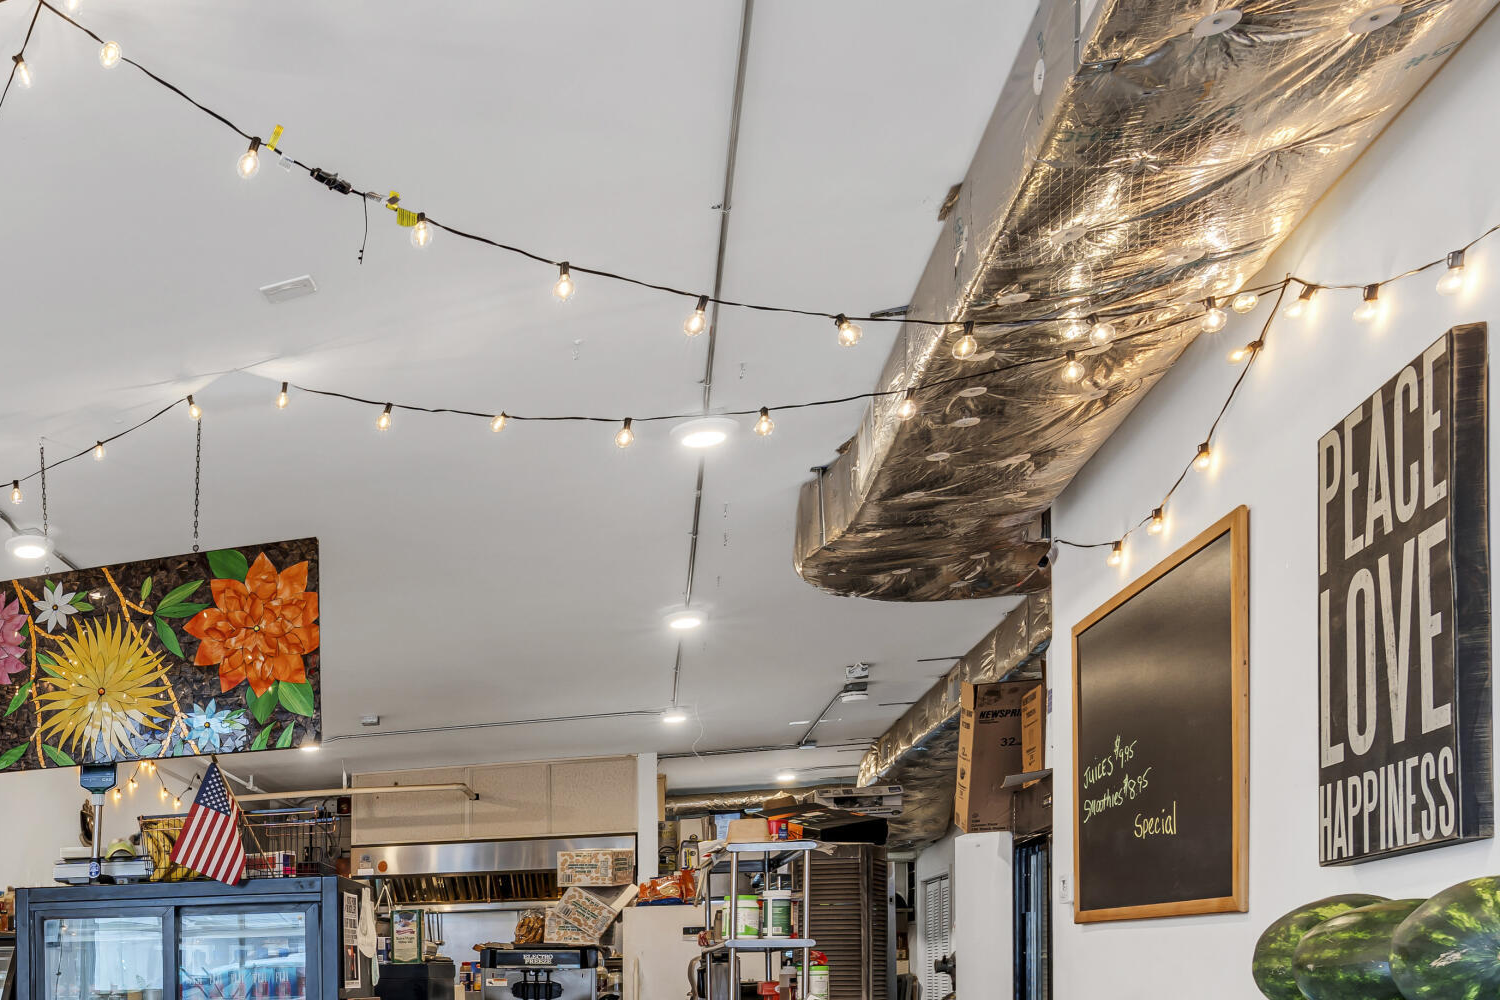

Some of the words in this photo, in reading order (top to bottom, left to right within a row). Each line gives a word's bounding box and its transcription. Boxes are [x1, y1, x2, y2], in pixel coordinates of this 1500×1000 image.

[1318, 341, 1448, 576] PEACE
[1320, 518, 1452, 768] LOVE
[1134, 800, 1177, 840] Special
[1319, 745, 1455, 862] HAPPINESS
